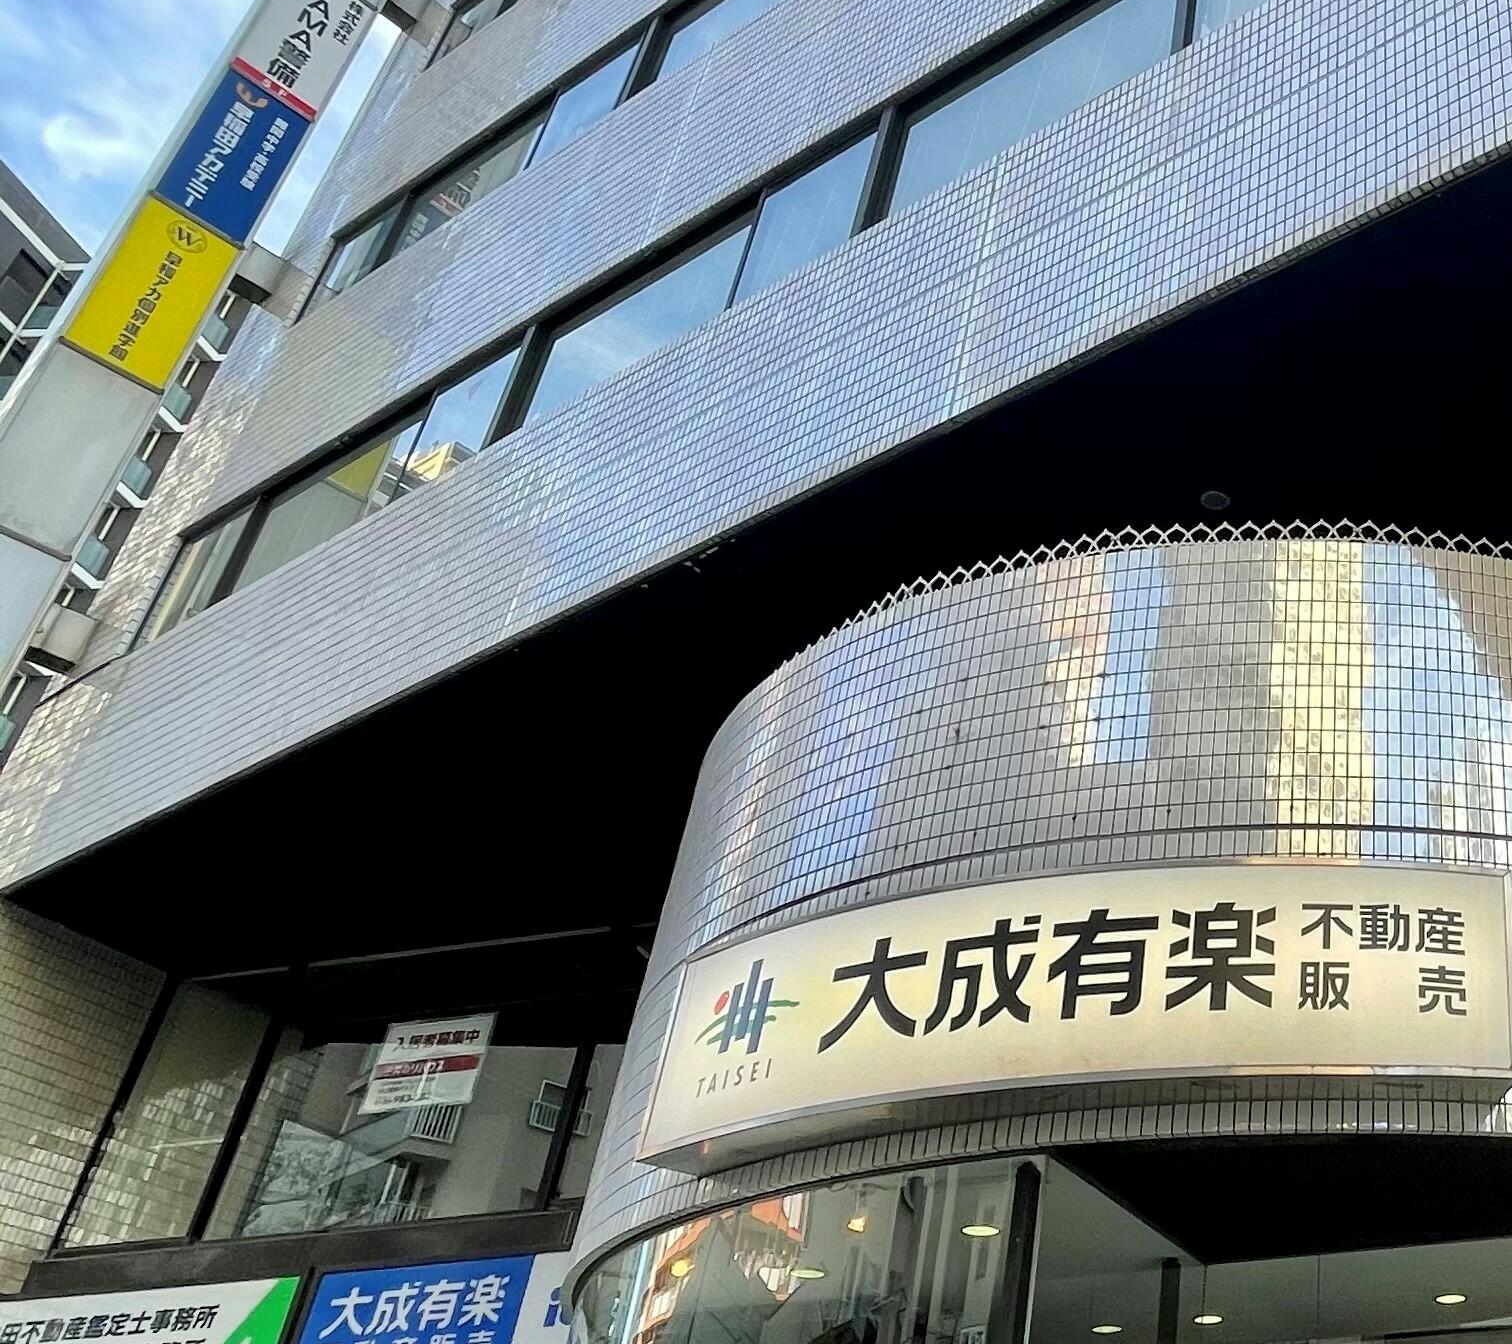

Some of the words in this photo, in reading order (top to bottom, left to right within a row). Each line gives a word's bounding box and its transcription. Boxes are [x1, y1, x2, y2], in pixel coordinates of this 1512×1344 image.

[333, 1, 365, 46] 株式会社
[185, 101, 255, 207] 早稲田アカデミー
[1300, 903, 1467, 958] 不動産
[816, 902, 1278, 1056] 大成有楽
[696, 1058, 772, 1098] TAISEI
[318, 1273, 511, 1341] 大成有楽
